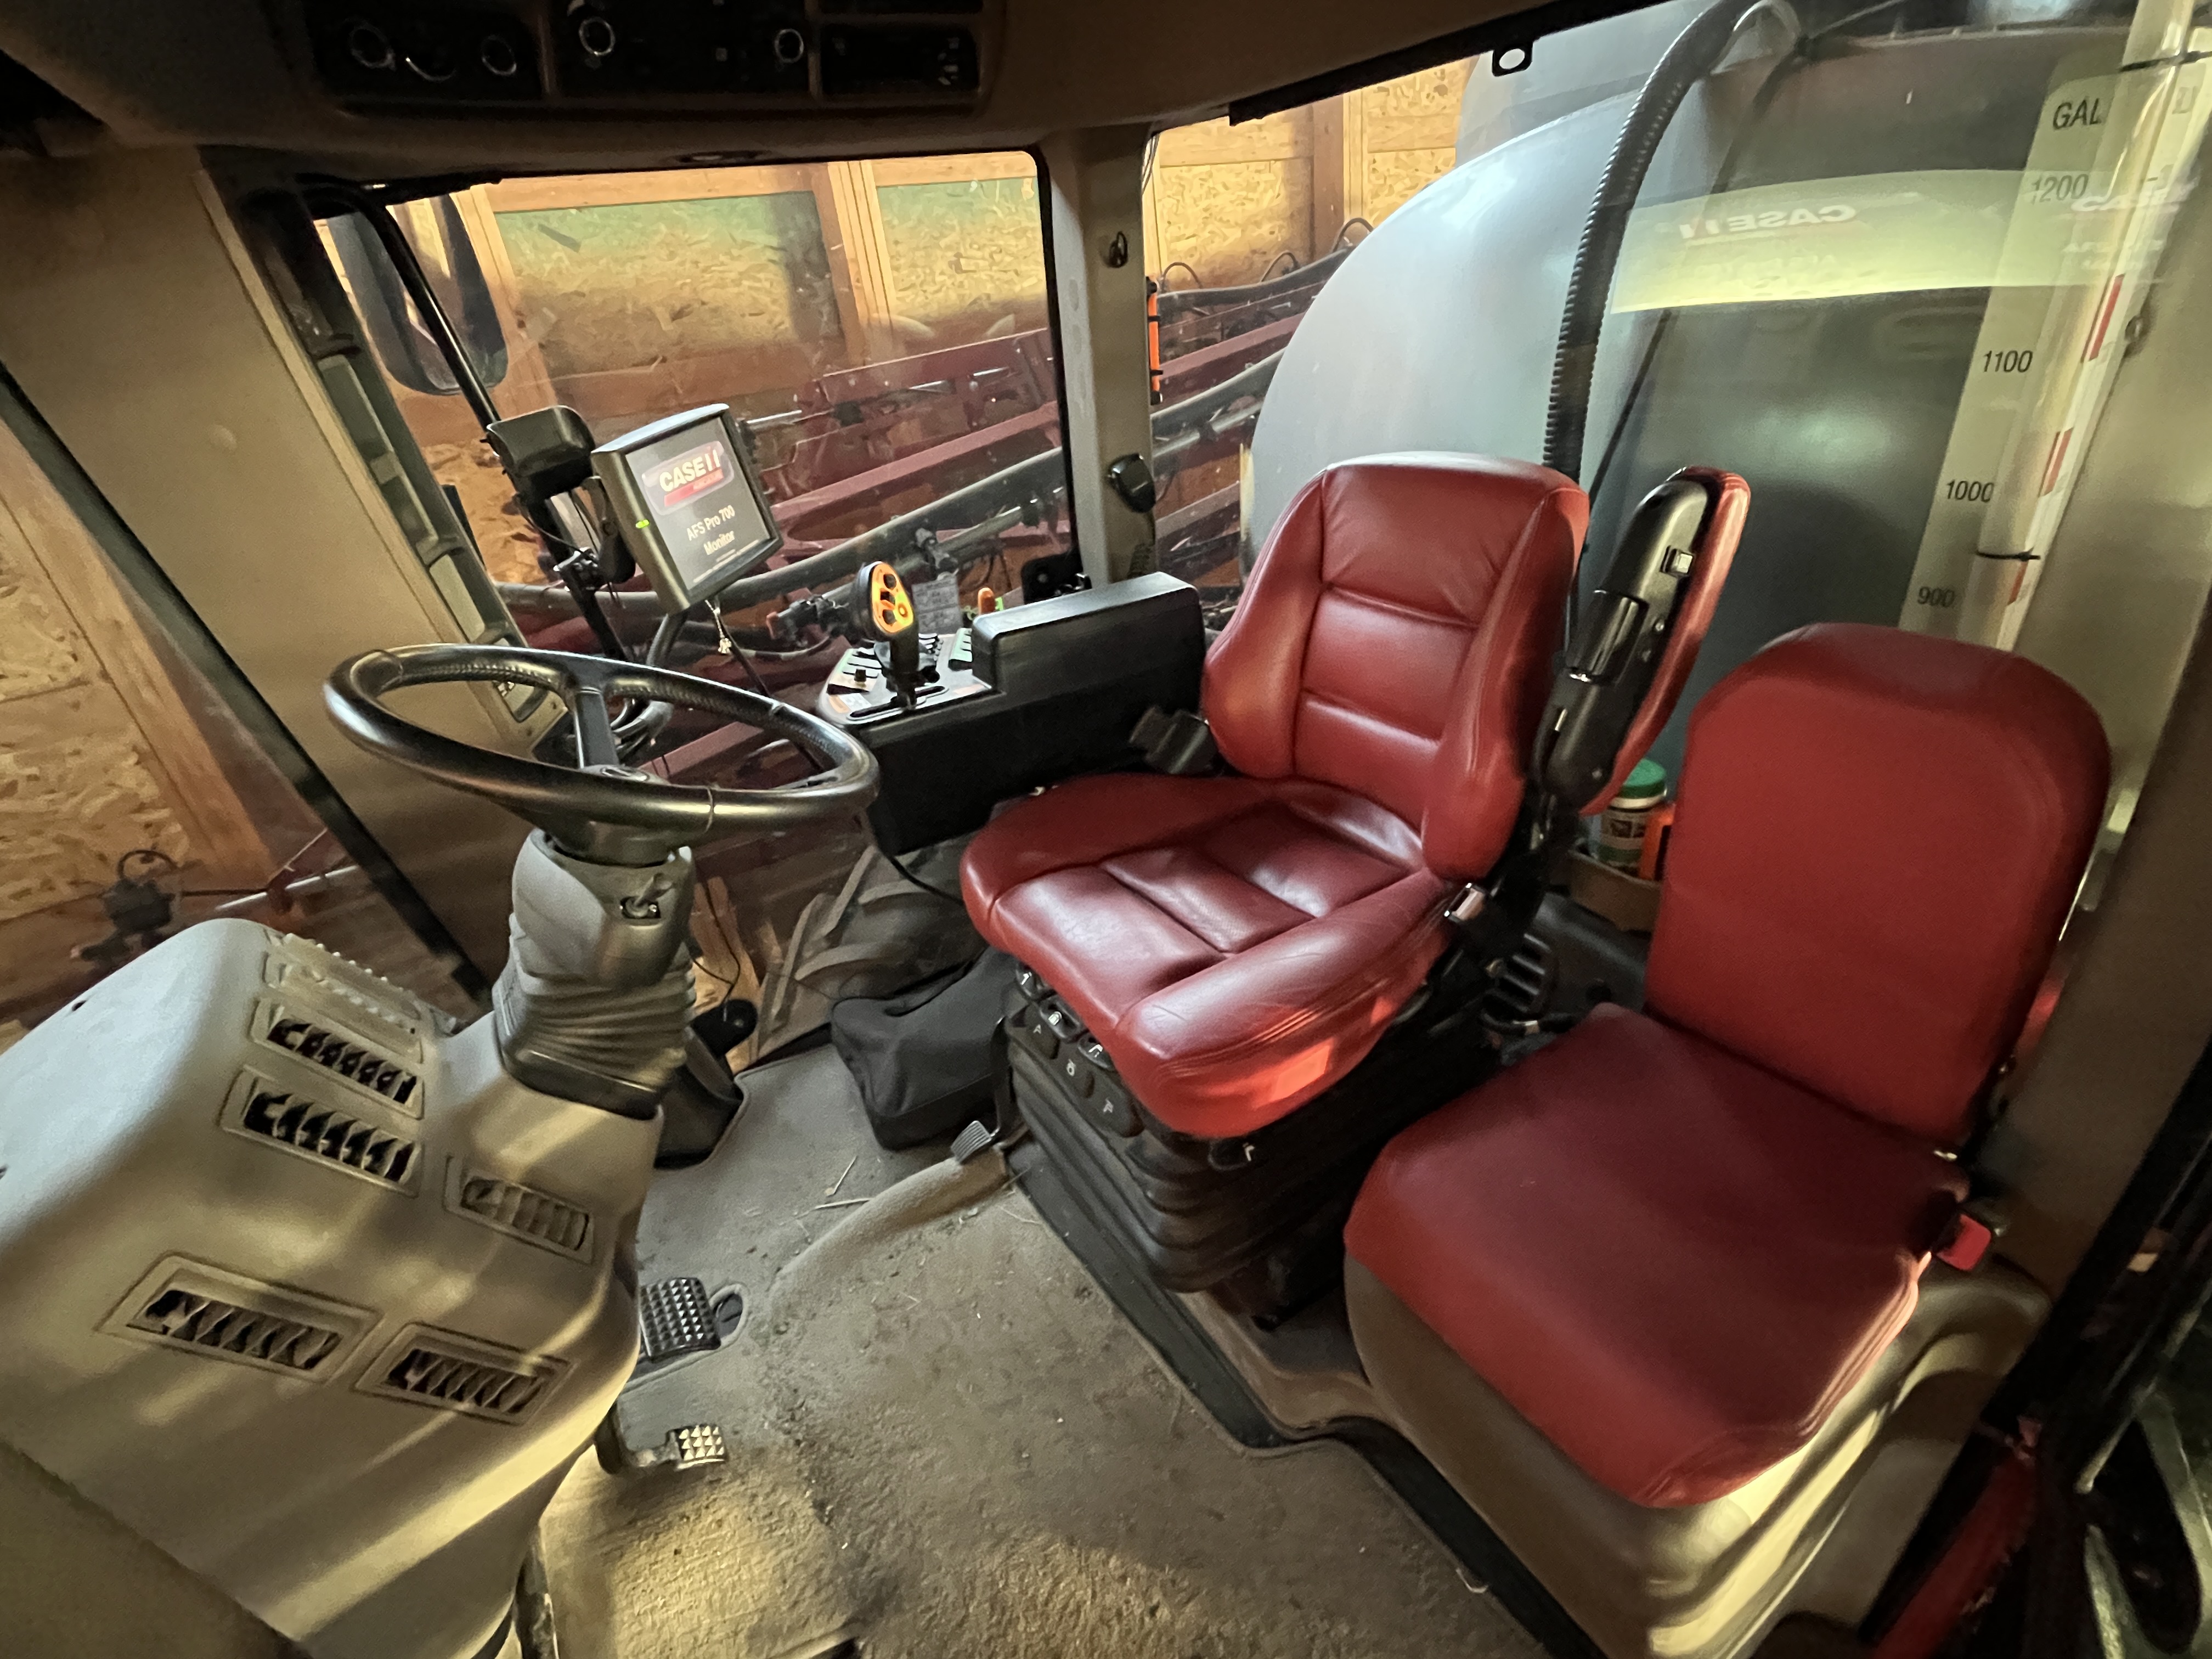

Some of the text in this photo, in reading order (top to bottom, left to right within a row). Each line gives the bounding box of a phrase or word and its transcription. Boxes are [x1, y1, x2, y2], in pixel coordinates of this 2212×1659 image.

[2052, 97, 2101, 130] GAL
[2031, 174, 2089, 205] 1200
[1982, 349, 2033, 373] 1100
[1945, 479, 1994, 502] 1000
[686, 504, 736, 541] AFS Pro 700
[703, 530, 735, 555] Monitor
[1917, 586, 1956, 607] 900
